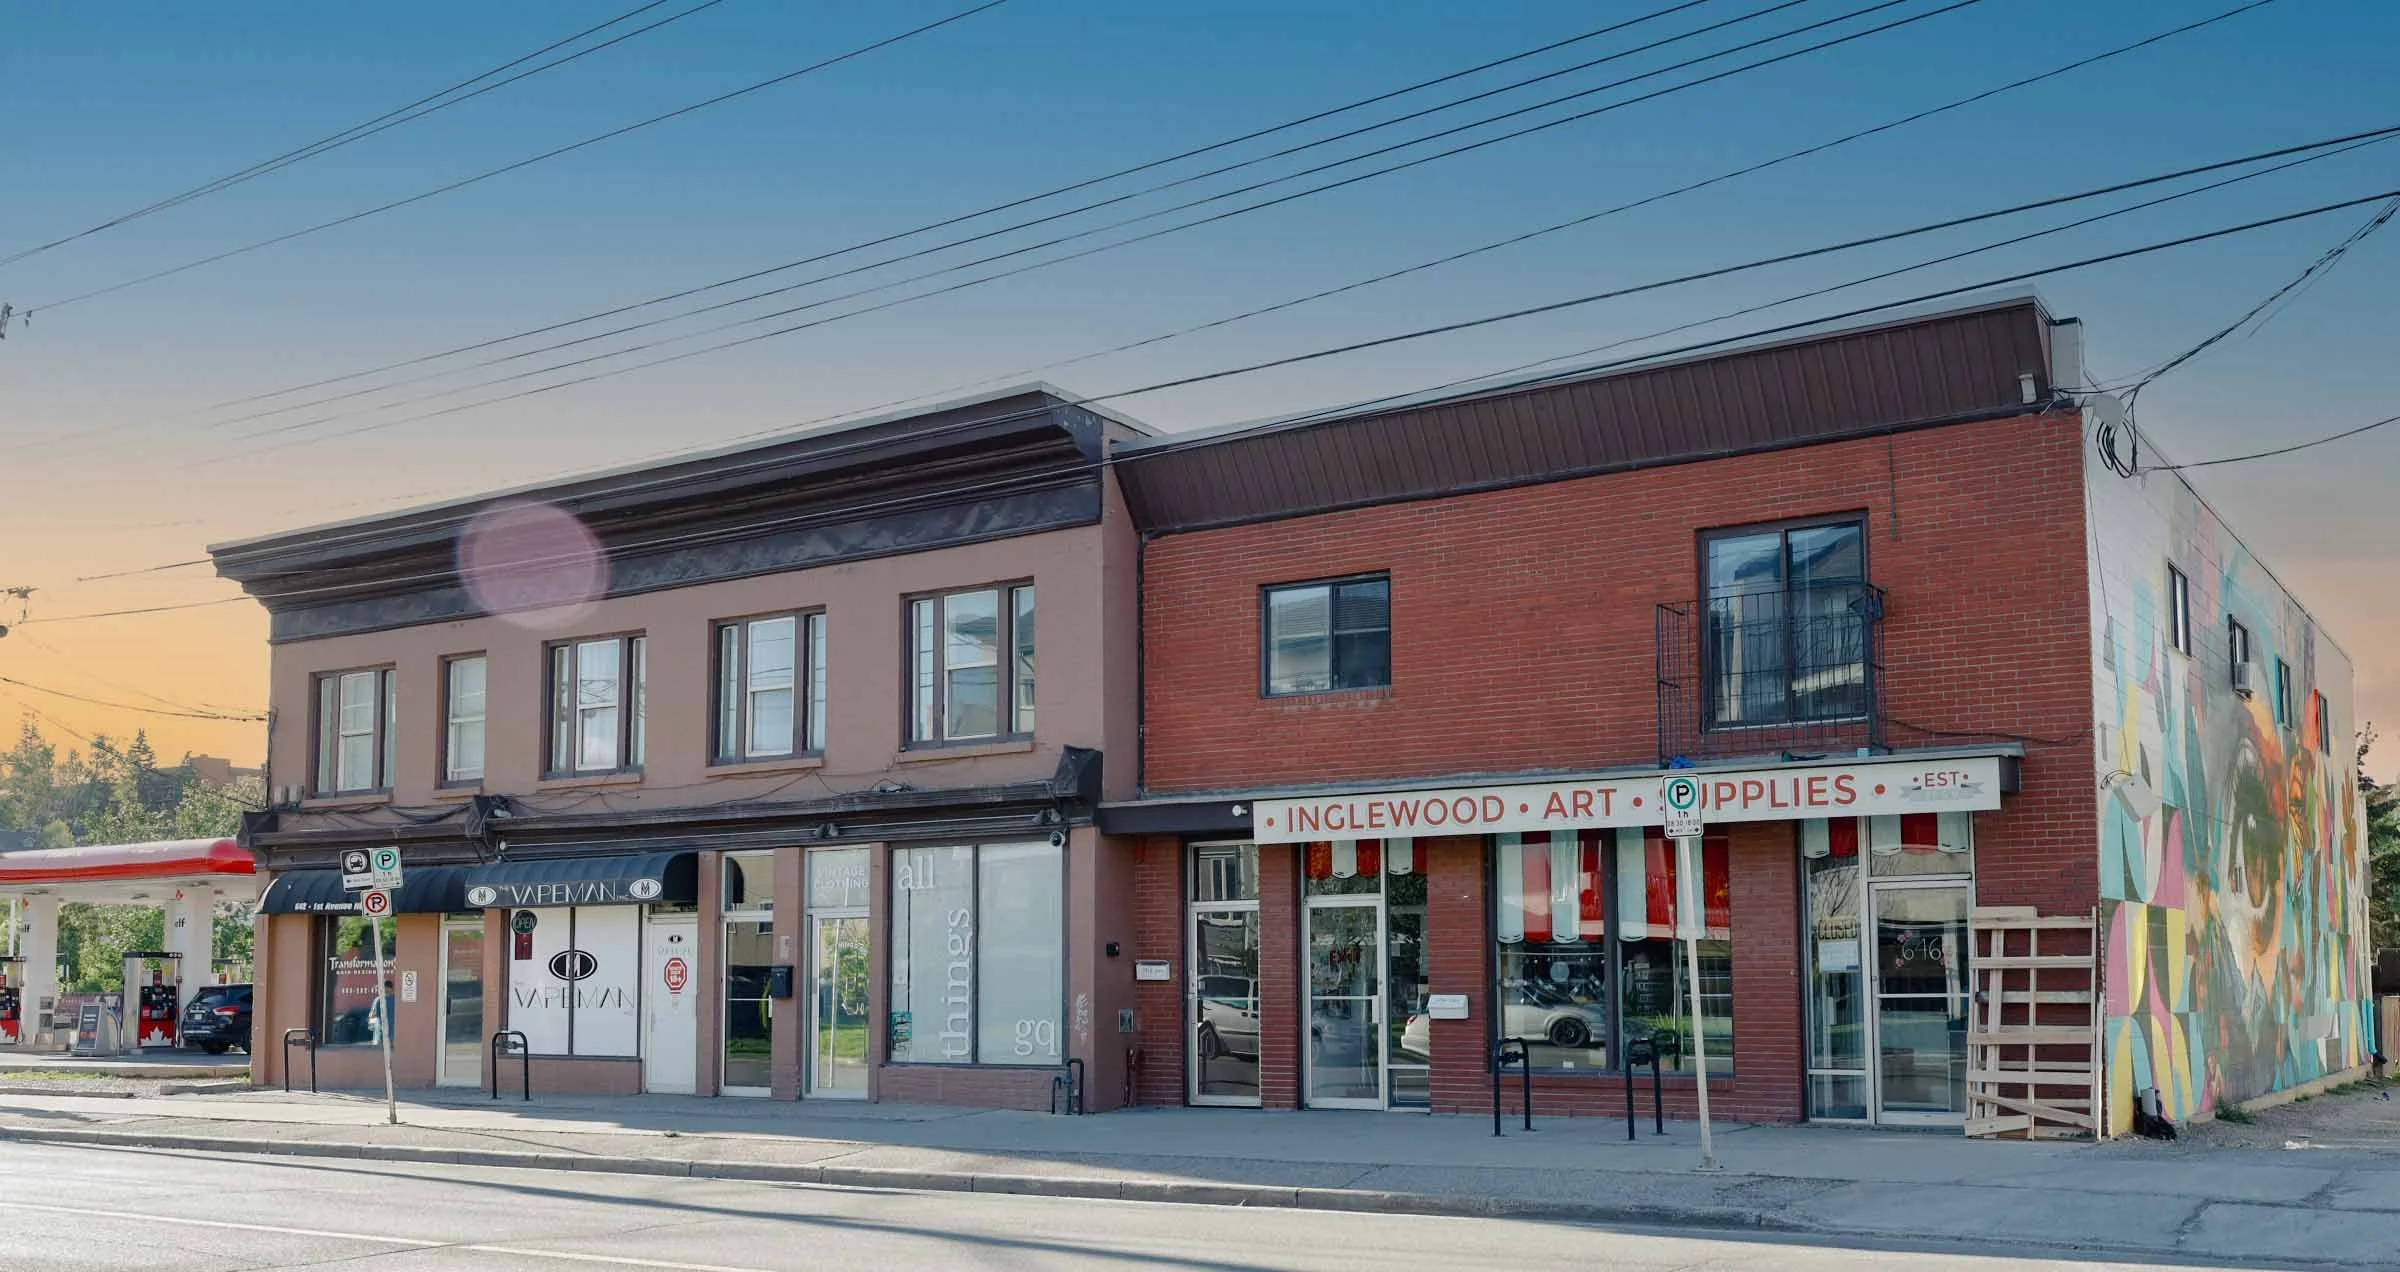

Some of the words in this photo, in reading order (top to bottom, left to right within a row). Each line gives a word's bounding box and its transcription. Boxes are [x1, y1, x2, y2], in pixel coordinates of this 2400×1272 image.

[1925, 771, 1960, 787] EST
[1287, 796, 1505, 833] INGLEWOOD
[1543, 788, 1618, 820] ART
[1658, 774, 1857, 812] PPLIES
[1676, 784, 1690, 804] P
[381, 854, 392, 867] P
[899, 855, 935, 889] all
[511, 882, 616, 904] VAPEMAN
[329, 956, 397, 970] Transformaon
[939, 907, 972, 1058] things
[1014, 1018, 1058, 1056] gq
